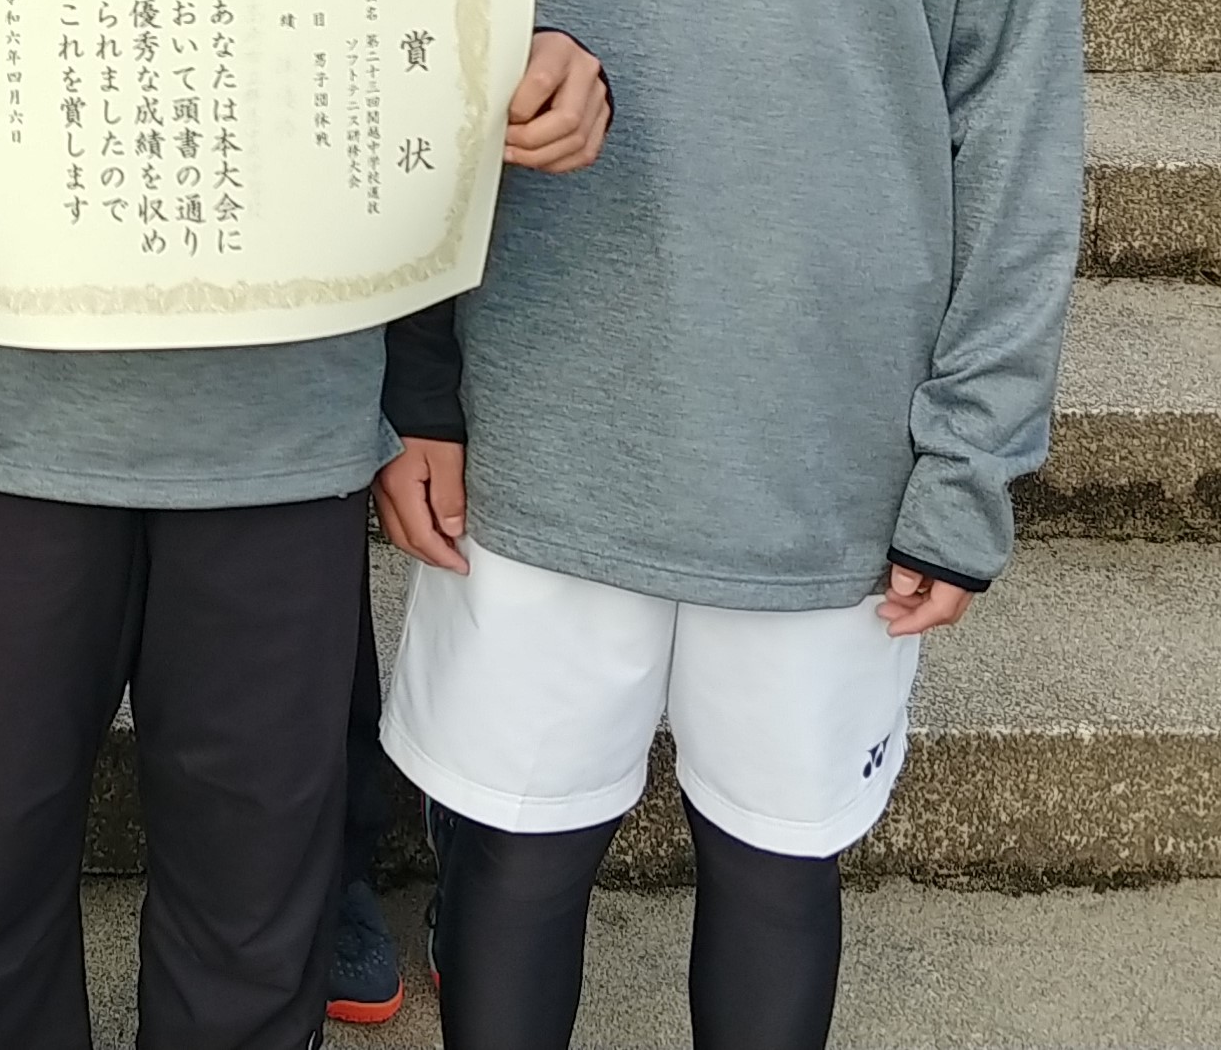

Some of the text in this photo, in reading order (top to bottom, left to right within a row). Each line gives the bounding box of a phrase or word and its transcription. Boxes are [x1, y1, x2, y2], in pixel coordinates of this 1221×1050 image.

[57, 3, 89, 226] これを賞します
[95, 0, 129, 224] られましたので
[171, 0, 207, 258] おいて頭書の通り
